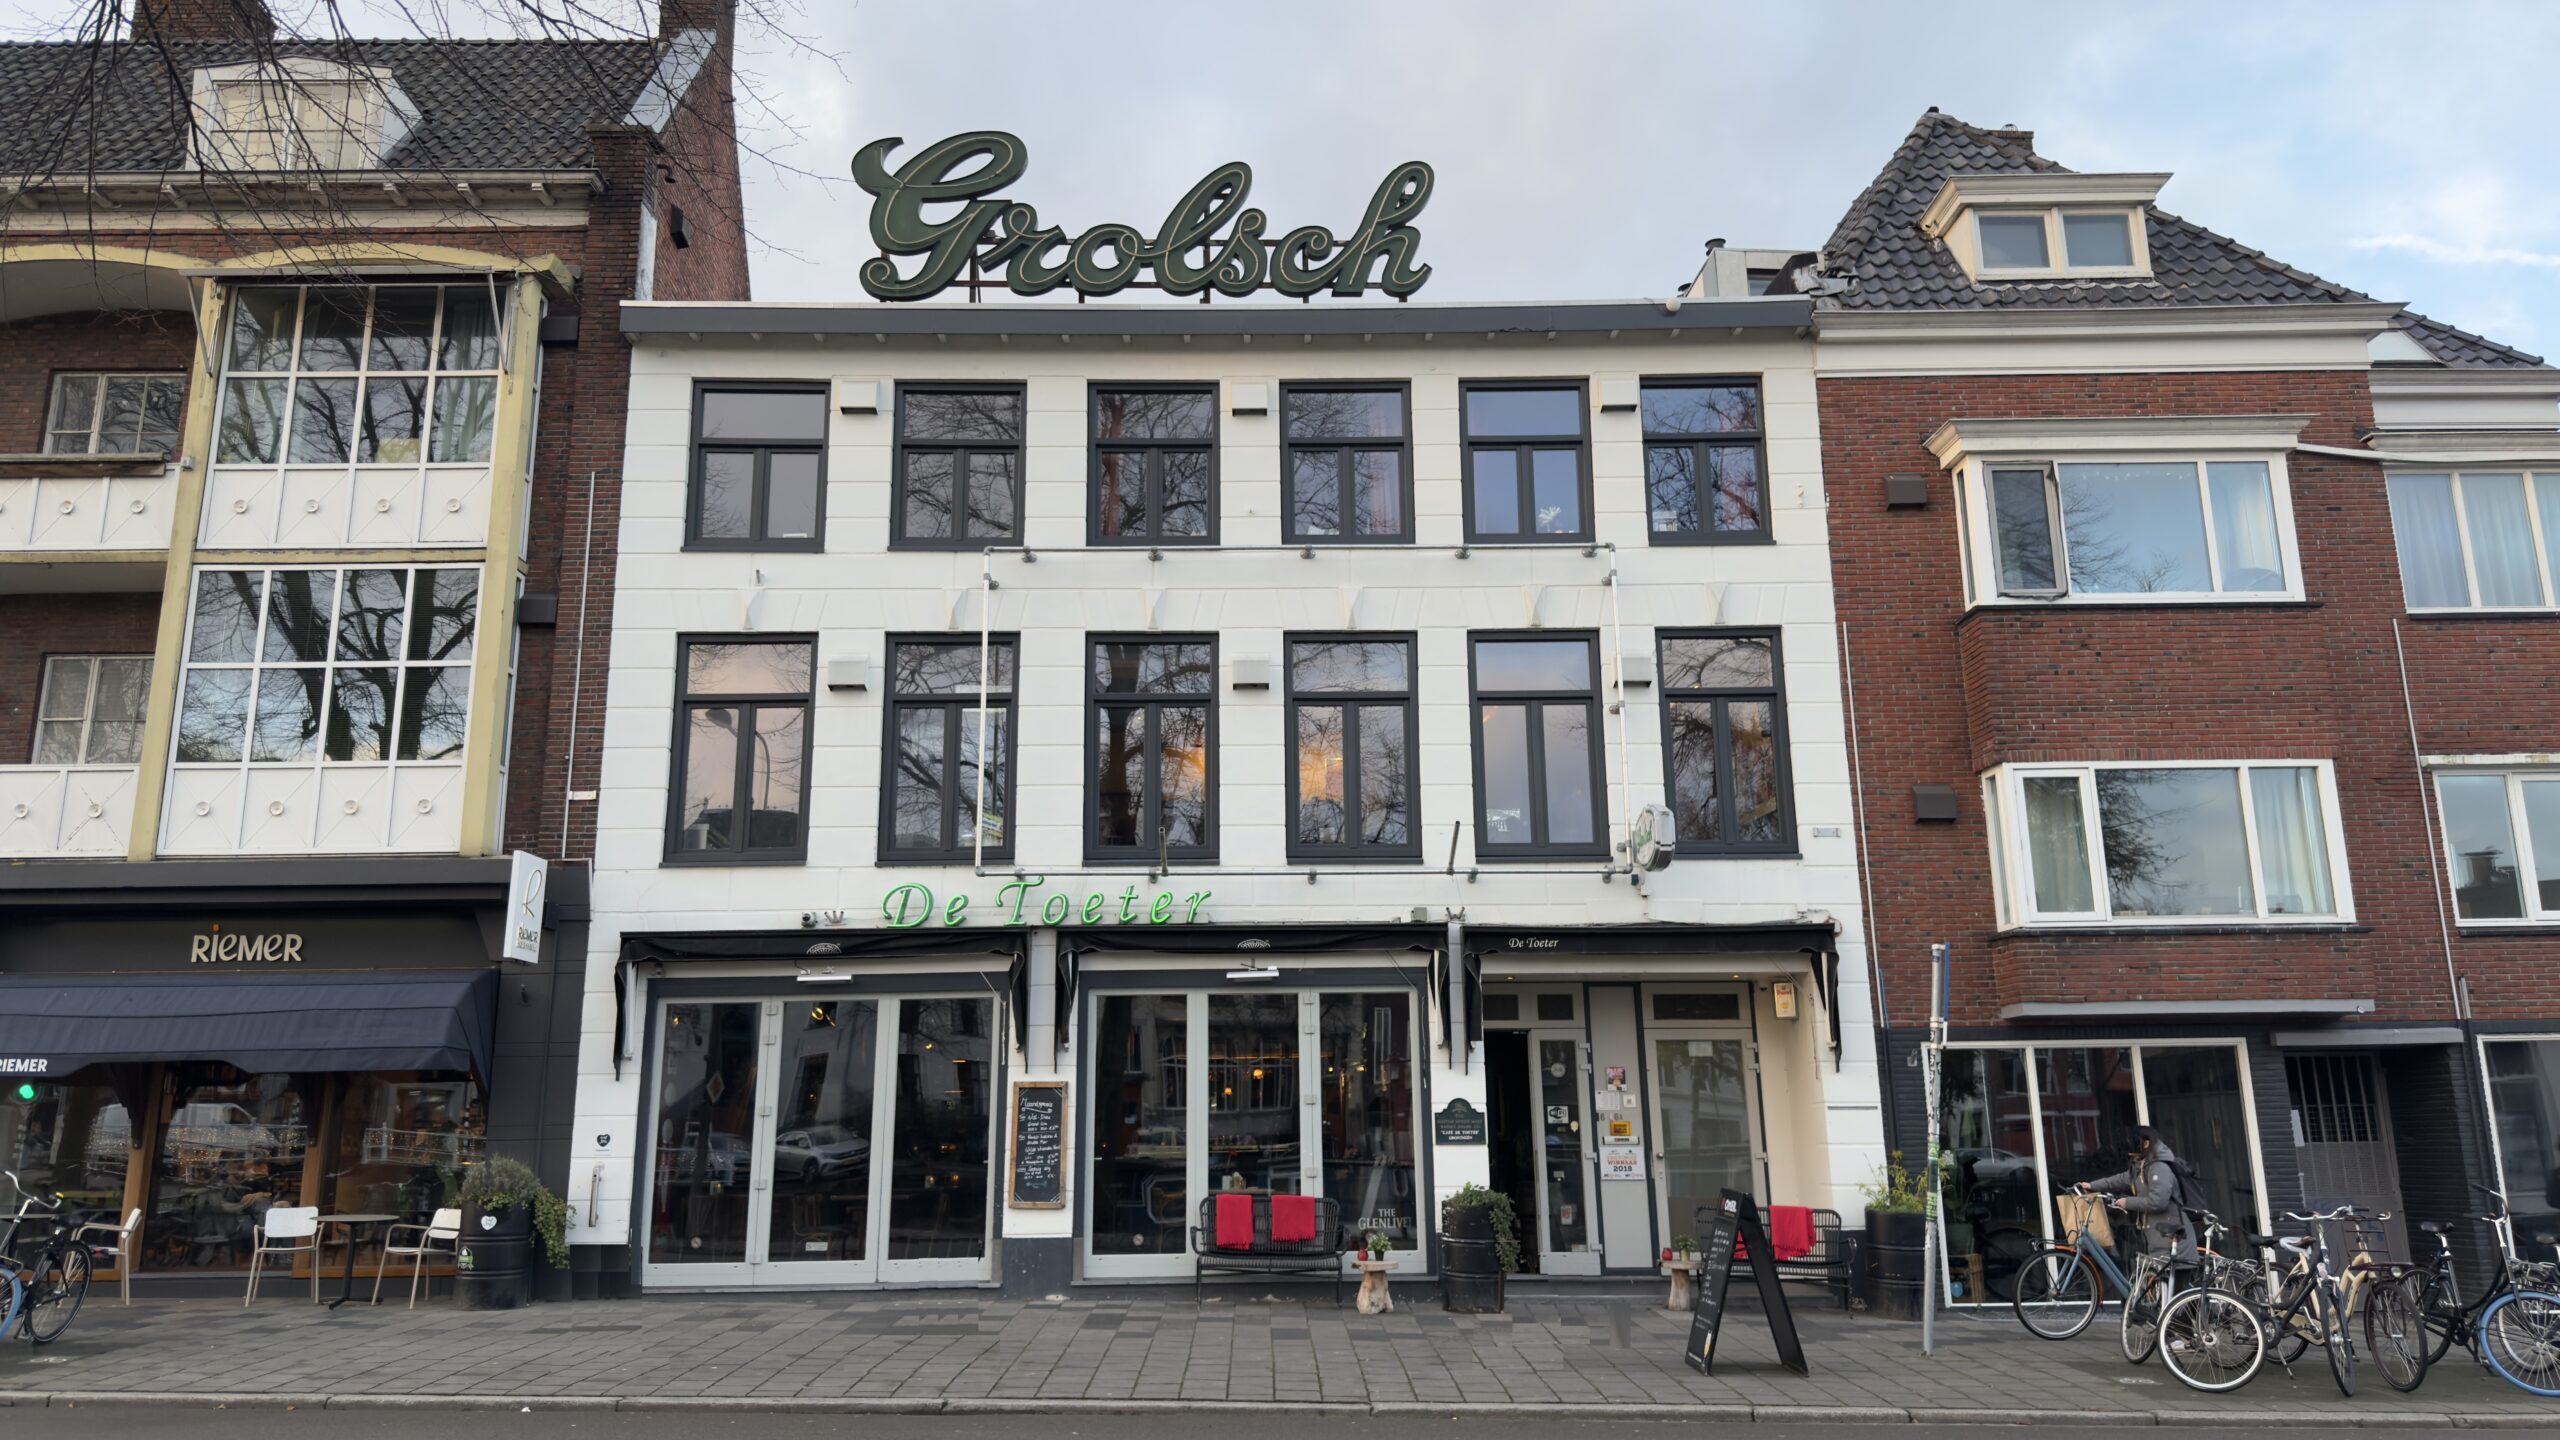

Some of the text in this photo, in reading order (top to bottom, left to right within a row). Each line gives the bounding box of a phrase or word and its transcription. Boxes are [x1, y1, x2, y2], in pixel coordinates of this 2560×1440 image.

[851, 130, 1436, 302] Grolsch
[881, 875, 1212, 928] De Toeter
[1508, 937, 1560, 948] De Toeter
[1378, 1208, 1396, 1217] THE
[1358, 1217, 1412, 1230] GLENLIVET
